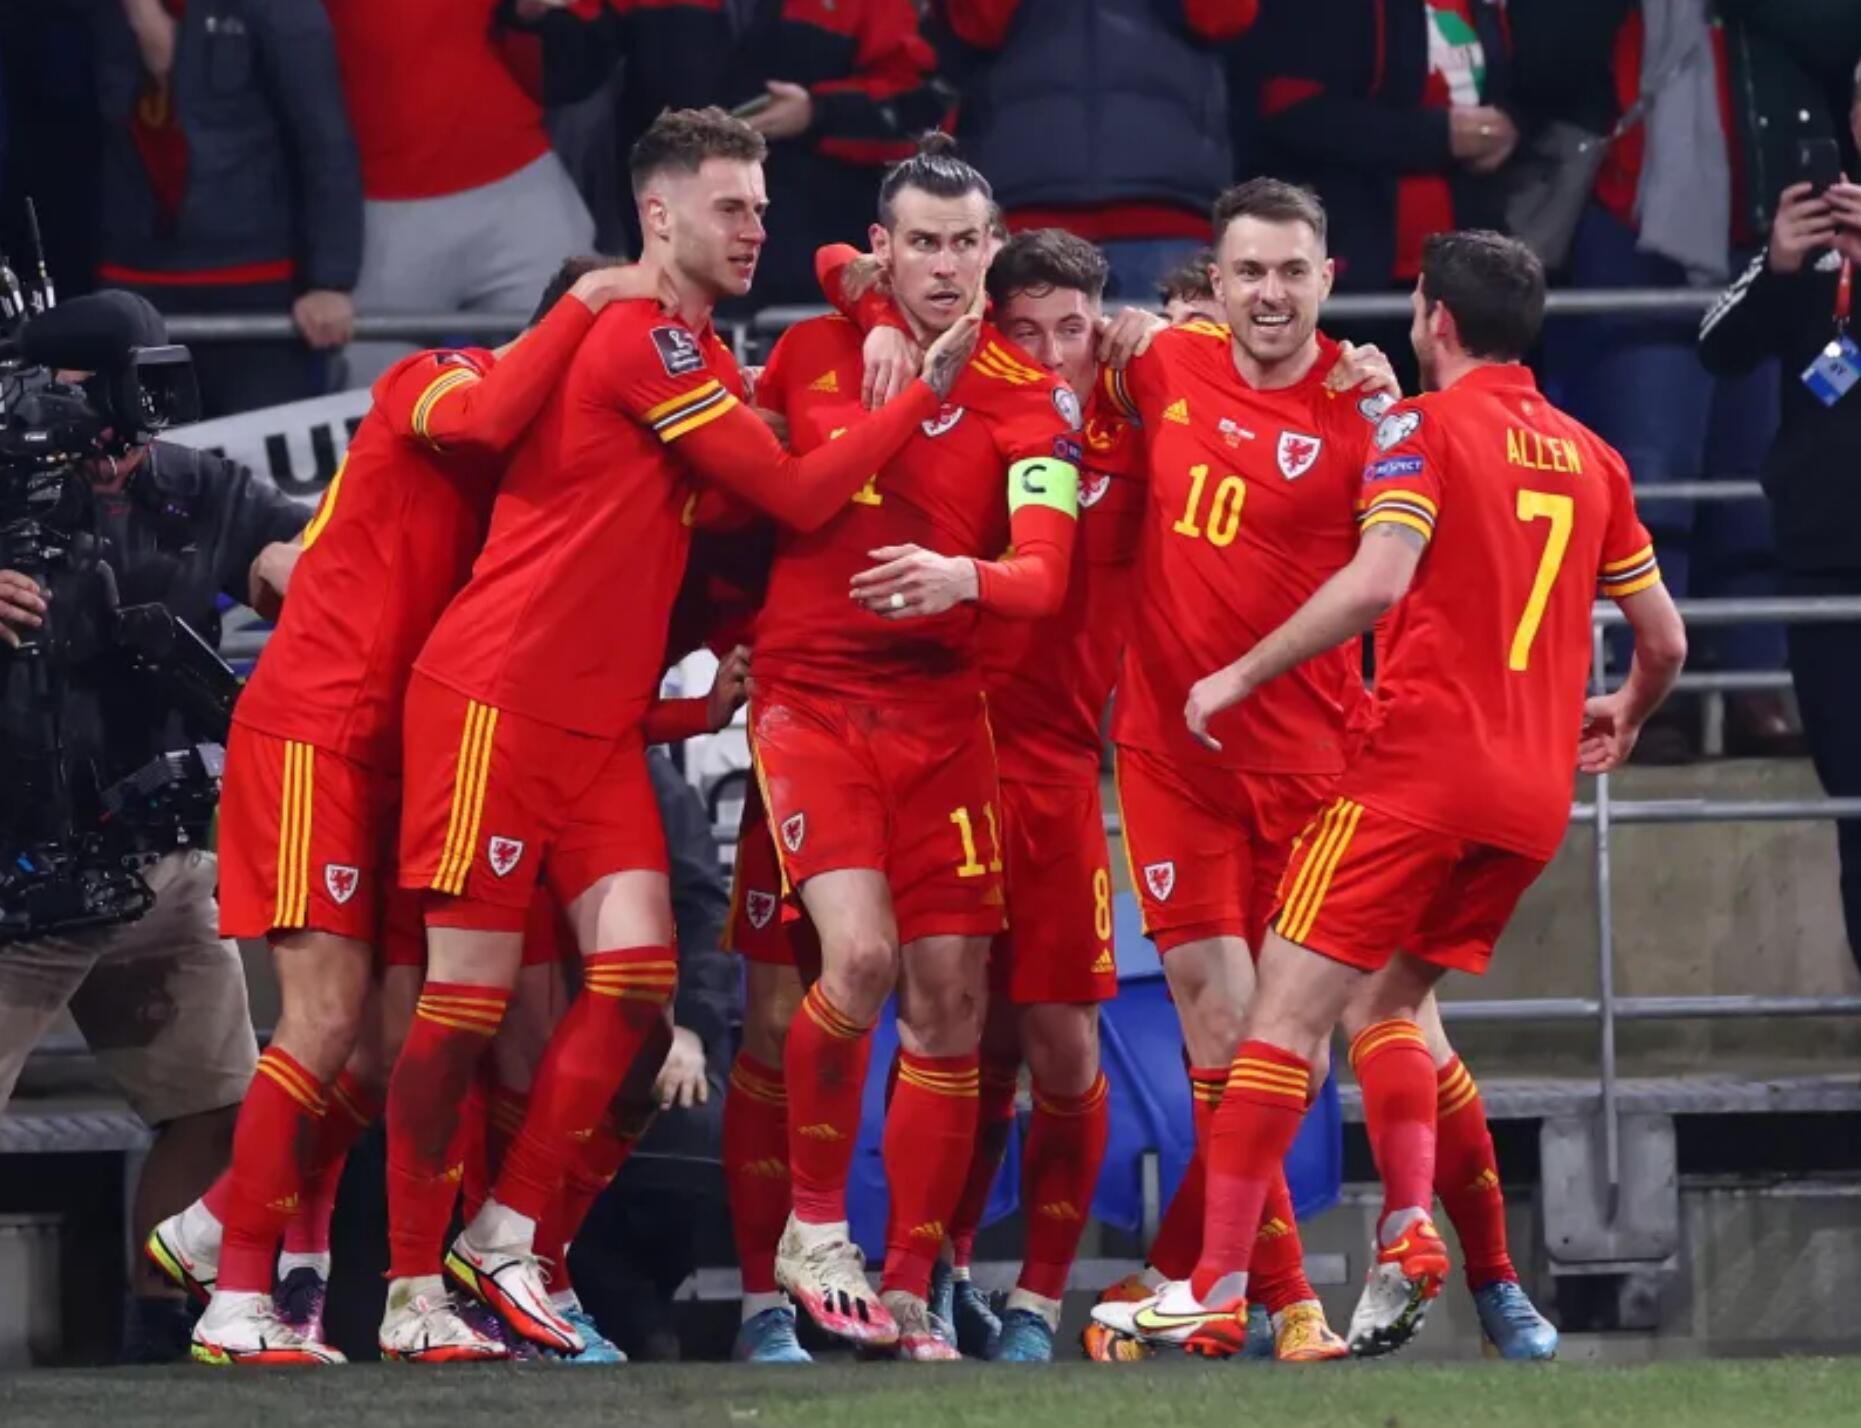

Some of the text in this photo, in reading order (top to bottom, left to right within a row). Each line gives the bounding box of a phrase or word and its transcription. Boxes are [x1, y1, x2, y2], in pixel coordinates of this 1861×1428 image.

[1023, 464, 1047, 493] C
[1507, 428, 1582, 474] ALLEN
[1173, 464, 1246, 547] 10
[1509, 489, 1573, 671] 7
[1093, 869, 1112, 940] 8
